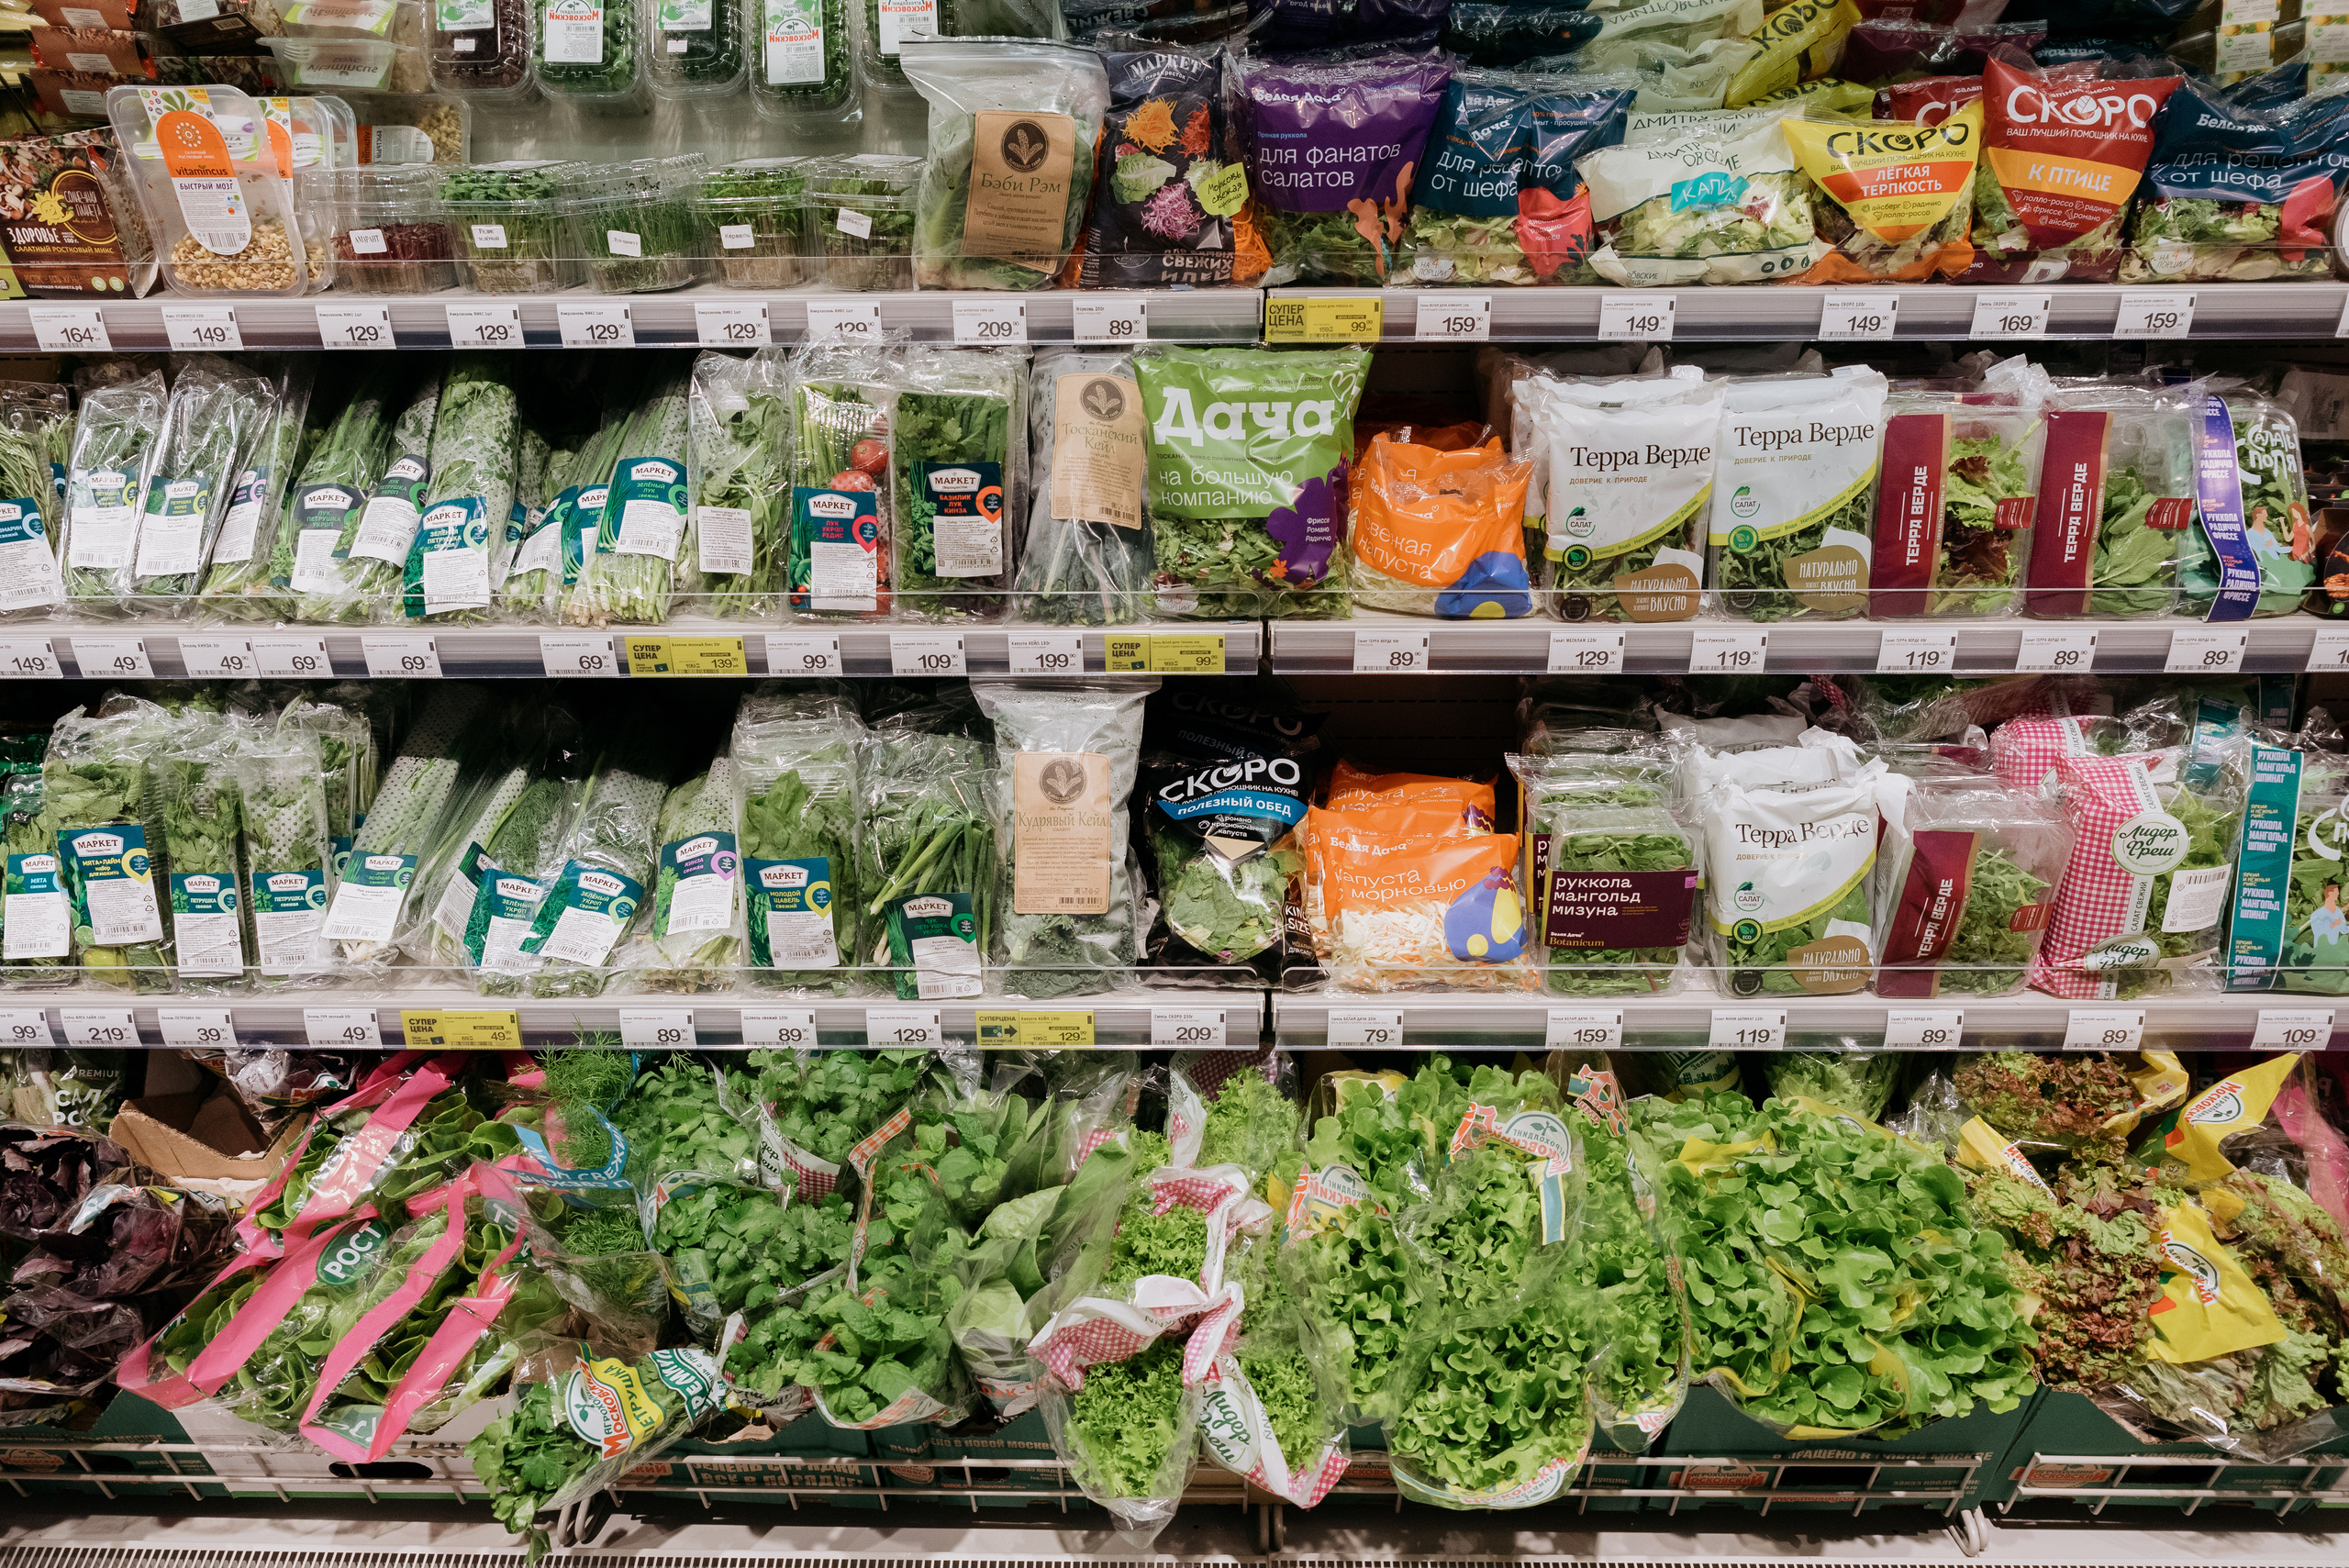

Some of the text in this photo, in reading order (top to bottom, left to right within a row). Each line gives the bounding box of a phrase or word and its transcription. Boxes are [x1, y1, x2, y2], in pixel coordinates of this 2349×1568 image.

[2006, 85, 2158, 129] СКОРО
[2006, 127, 2068, 139] ВАШ ЛУЧШИЙ
[1826, 122, 1969, 160] СКОРО
[1260, 143, 1401, 165] для фанатов
[1437, 150, 1476, 174] для
[176, 165, 228, 176] vitamincus
[1876, 164, 1931, 181] ЛЁГКАЯ
[2028, 162, 2112, 192] К ПТИЦЕ
[180, 181, 233, 190] БЫСТРЫЙ МОЗГ
[981, 172, 1061, 194] Бэби Рэм
[1262, 171, 1354, 187] салатов
[2170, 171, 2282, 190] от шефа
[1431, 173, 1519, 201] от шефа
[1861, 178, 1943, 197] ТЕРПКОСТЬ
[2022, 194, 2075, 208] лолло-россо
[2048, 218, 2079, 228] айсберг
[6, 228, 61, 243] ЗДОРОВЬЕ
[1162, 256, 1232, 271] СВЕЖИХ
[1351, 321, 1366, 332] 99
[1442, 317, 1475, 332] 159
[1626, 316, 1659, 331] 149
[1848, 316, 1880, 331] 149
[1998, 315, 2032, 331] 169
[2143, 312, 2177, 328] 159
[60, 327, 94, 343] 164
[193, 327, 226, 343] 149
[345, 326, 379, 341] 129
[585, 324, 619, 340] 129
[977, 321, 1012, 337] 209
[1153, 386, 1336, 448] Дача
[1062, 421, 1139, 446] Тосканский
[1733, 422, 1875, 451] Терра Верде
[1084, 437, 1117, 455] Кейл
[1570, 443, 1711, 473] Терра Верде
[1733, 453, 1812, 465] ДОВЕРИЕ ПРИРОДЕ
[635, 467, 674, 477] МАРКЕТ
[1159, 465, 1295, 488] на большую
[637, 481, 666, 491] ЗЕЛЁНЫЙ
[934, 474, 976, 486] МАРКЕТ
[1569, 475, 1648, 485] ДОВЕРИЕ ПРИРОДЕ
[307, 493, 349, 506] МАРКЕТ
[940, 494, 972, 502] БАЗИЛИК
[1160, 486, 1274, 507] компанию
[1734, 500, 1756, 508] САЛАТ
[813, 501, 852, 511] МАРКЕТ
[944, 506, 968, 515] КИНЗА
[427, 509, 463, 524] МАРКЕТ
[1307, 517, 1330, 525] Фриссе
[1906, 465, 1929, 566] ТЕРРА ВЕРДЕ
[2206, 513, 2239, 522] РУККОЛА
[1570, 520, 1593, 528] САЛАТ
[2209, 523, 2241, 531] РАДИЧЧО
[1306, 534, 1332, 542] Радиччо
[2212, 532, 2239, 541] ФРИССЕ
[1799, 560, 1858, 579] НАТУРАЛЬНО
[2227, 568, 2255, 580] РУККОЛА
[1650, 595, 1687, 612] ВКУСНО
[2222, 591, 2251, 602] ФРИССЕ
[633, 644, 662, 652] СУПЕР
[1112, 641, 1141, 651] СУПЕР
[113, 656, 136, 670] 49
[220, 655, 243, 670] 49
[291, 656, 315, 670] 69
[401, 655, 424, 670] 69
[579, 655, 603, 669] 69
[634, 651, 658, 660] ЦЕНА
[803, 654, 827, 669] 99
[918, 654, 952, 669] 109
[1035, 653, 1069, 668] 199
[1196, 656, 1212, 666] 99
[1575, 650, 1609, 666] 129
[1716, 650, 1750, 665] 119
[1905, 650, 1940, 665] 119
[12, 656, 44, 671] 149
[711, 658, 733, 669] 139
[2256, 762, 2297, 774] МАНГОЛЬД
[1158, 757, 1301, 802] СКОРО
[2255, 773, 2285, 784] ШПИНАТ
[1177, 796, 1293, 817] ПОЛЕЗНЫЙ ОБЕД
[1735, 817, 1870, 849] Терра Верде
[2120, 825, 2180, 844] Лидер
[2249, 830, 2288, 842] МАНГОЛЬД
[1330, 837, 1368, 855] Белая
[2247, 841, 2277, 852] ШПИНАТ
[25, 858, 54, 868] МАРКЕТ
[367, 857, 401, 868] МАРКЕТ
[1351, 878, 1467, 903] морковью
[1554, 875, 1632, 892] руккола
[770, 889, 802, 899] МОЛОДОЙ
[774, 896, 800, 906] ЩАВЕЛЬ
[1553, 889, 1641, 905] мангольд
[1553, 903, 1619, 919] мизуна
[1917, 878, 1953, 959] ТЕРРА ВЕРДЕ
[1286, 917, 1310, 936] SIZE
[1549, 936, 1605, 948] Botanicum
[1802, 948, 1861, 966] НАТУРАЛЬНО
[979, 1015, 1017, 1023] СУПЕРЦЕНА
[12, 1025, 37, 1040] 99
[91, 1027, 125, 1040] 219
[197, 1028, 221, 1041] 39
[342, 1027, 366, 1040] 49
[491, 1030, 506, 1040] 49
[657, 1028, 682, 1042] 89
[777, 1027, 803, 1041] 89
[894, 1029, 927, 1042] 129
[1175, 1027, 1212, 1040] 209
[1364, 1029, 1388, 1043] 79
[1573, 1029, 1608, 1042] 159
[1735, 1029, 1771, 1042] 119
[1921, 1029, 1947, 1043] 89
[2102, 1029, 2128, 1044] 89
[2281, 1029, 2317, 1043] 109
[323, 1221, 384, 1280] РОСТ
